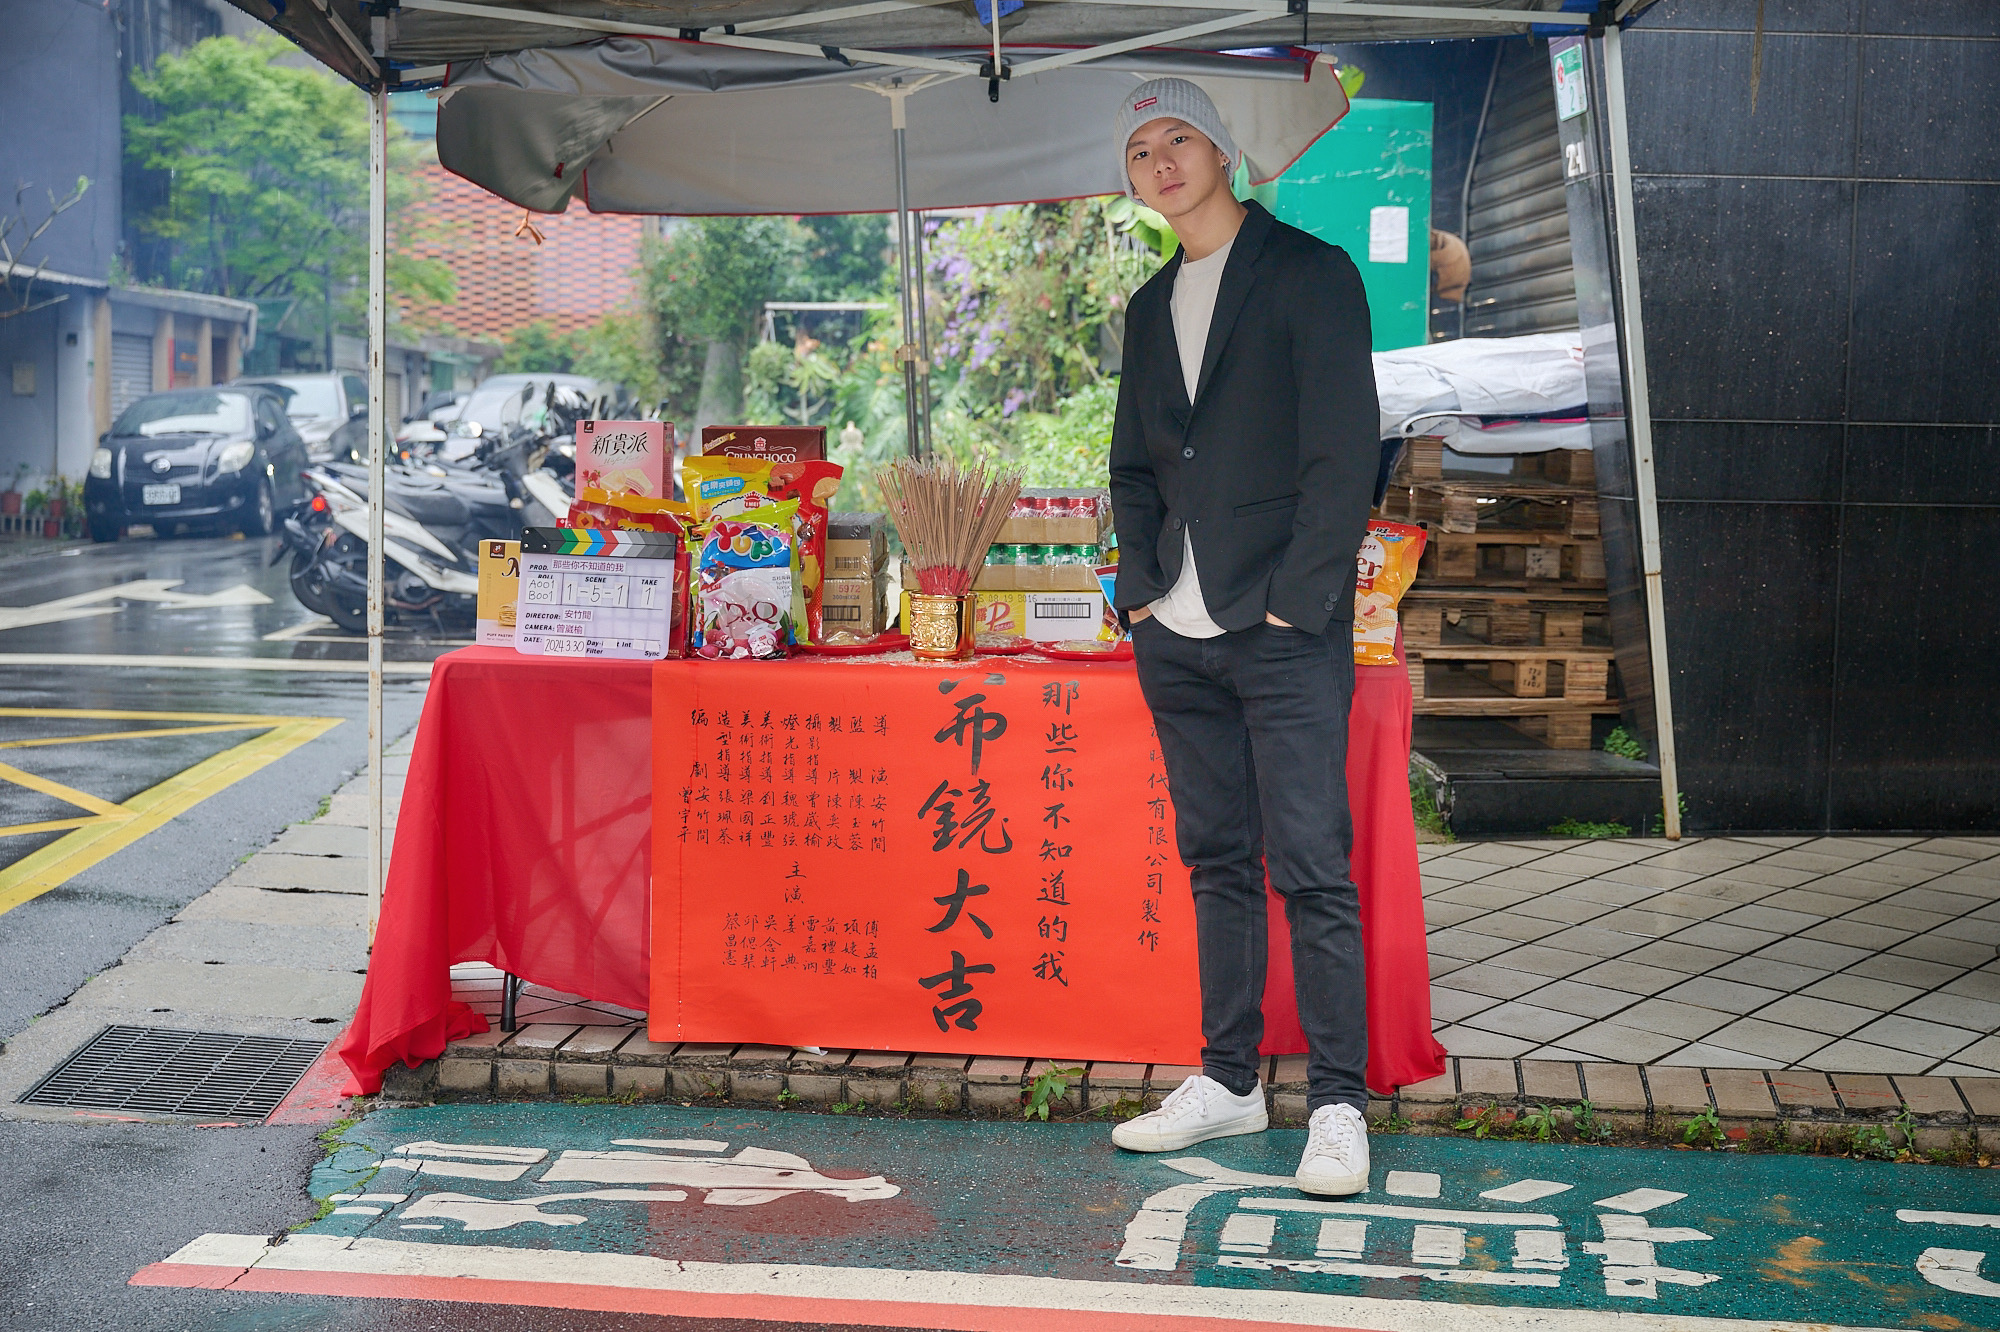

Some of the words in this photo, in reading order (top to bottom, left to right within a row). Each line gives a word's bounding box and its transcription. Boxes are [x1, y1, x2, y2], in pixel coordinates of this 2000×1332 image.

[590, 432, 650, 456] 新貴派
[715, 521, 785, 562] Yupi
[552, 560, 624, 573] 那些你不知道的我
[839, 584, 861, 593] 5972
[646, 587, 652, 606] 1
[1003, 594, 1014, 603] 19
[525, 612, 561, 620] DIRECTOR:
[524, 624, 555, 632] CAMERA:
[523, 636, 543, 644] DATE:
[644, 650, 660, 658] Sync
[1032, 680, 1080, 987] 那些你不知道的我
[783, 861, 807, 904] 主演
